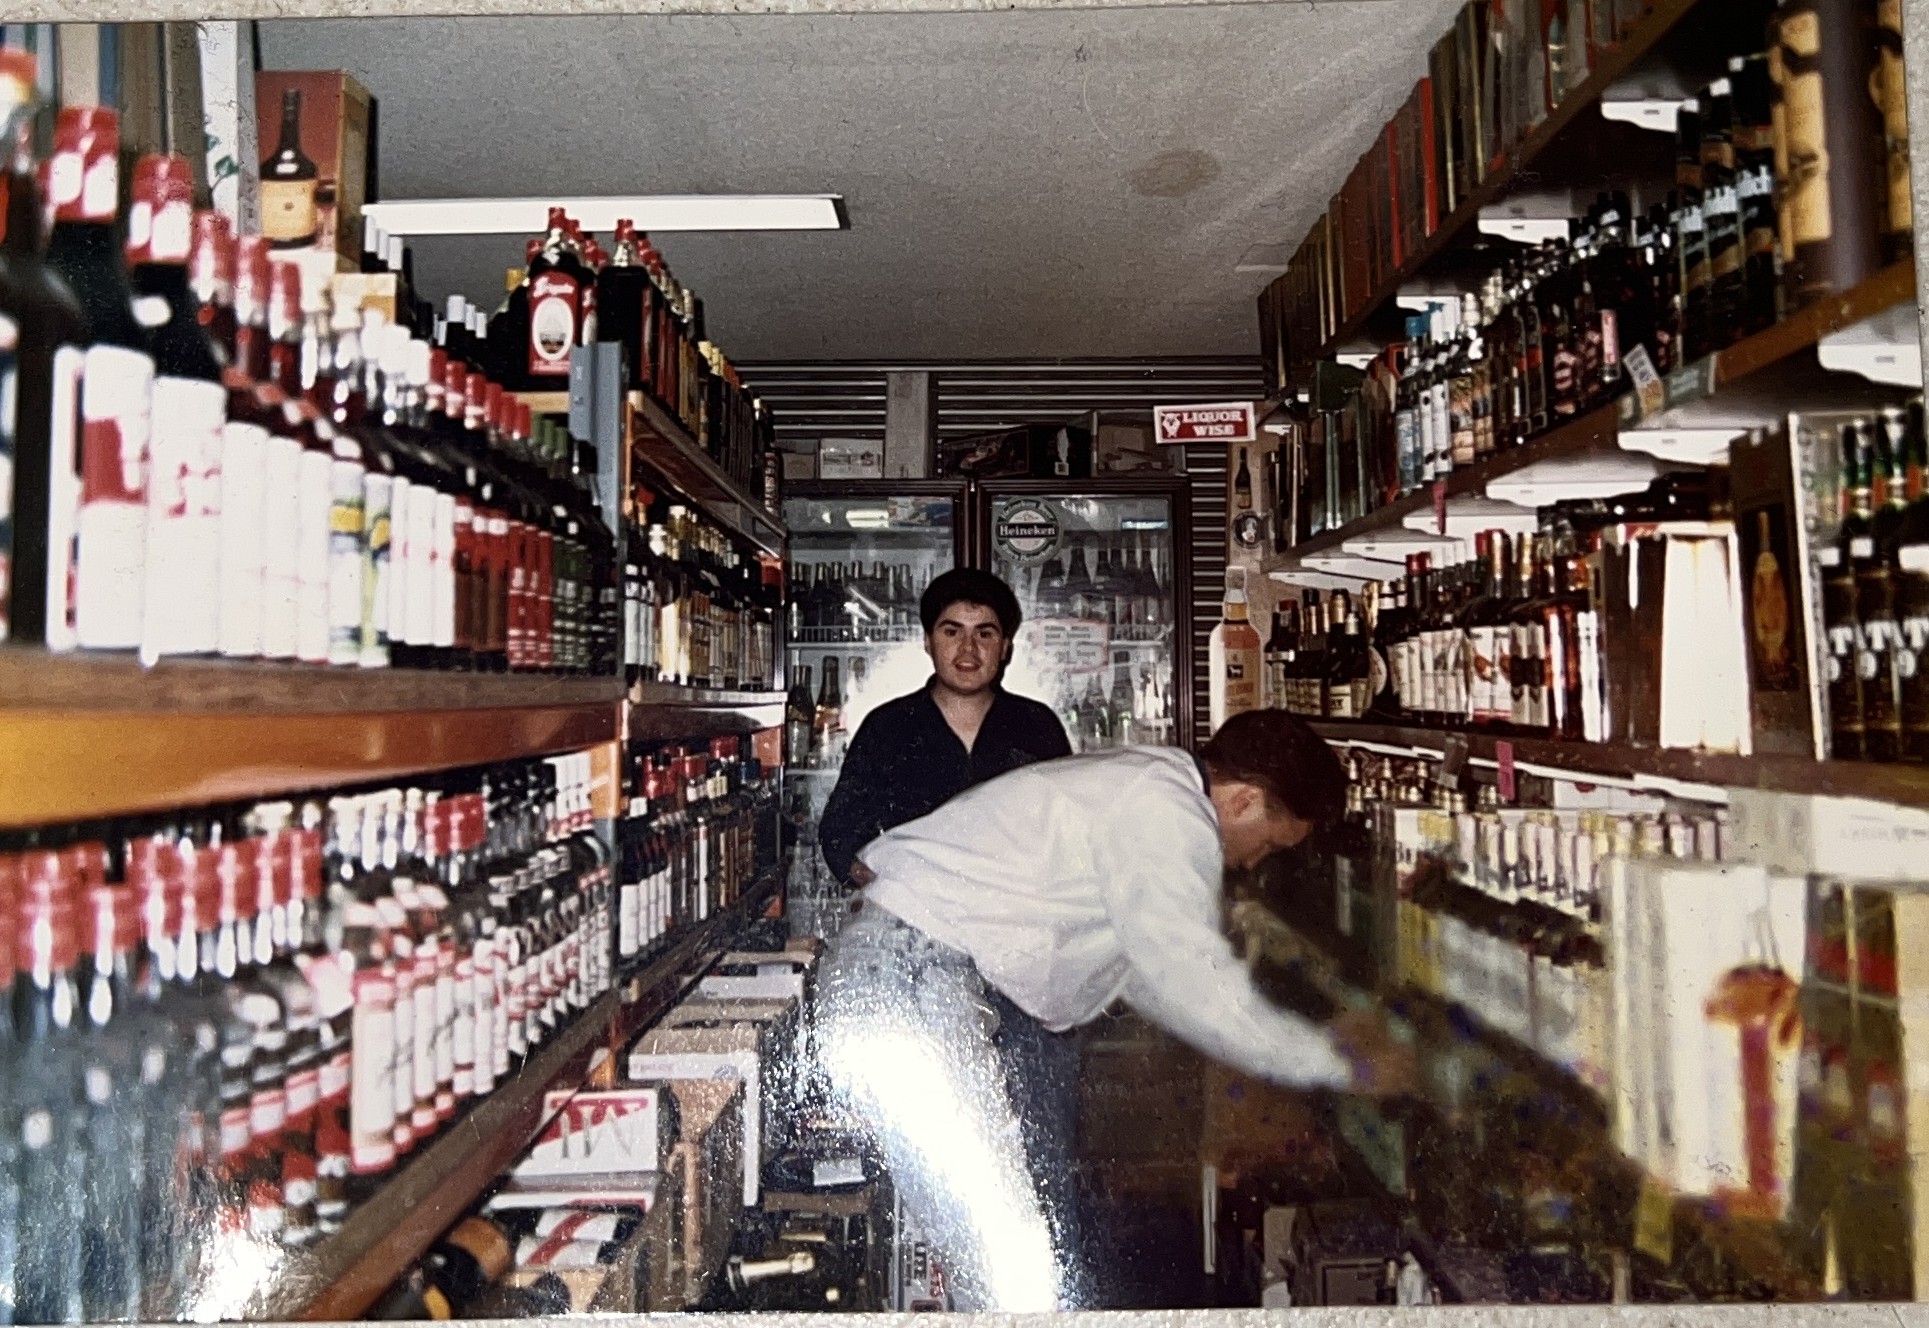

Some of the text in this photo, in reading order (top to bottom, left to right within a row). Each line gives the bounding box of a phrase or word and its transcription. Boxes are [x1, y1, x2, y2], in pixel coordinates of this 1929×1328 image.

[1182, 410, 1243, 424] LIQUOR
[1192, 424, 1235, 437] WISE
[1000, 524, 1055, 536] Heineken
